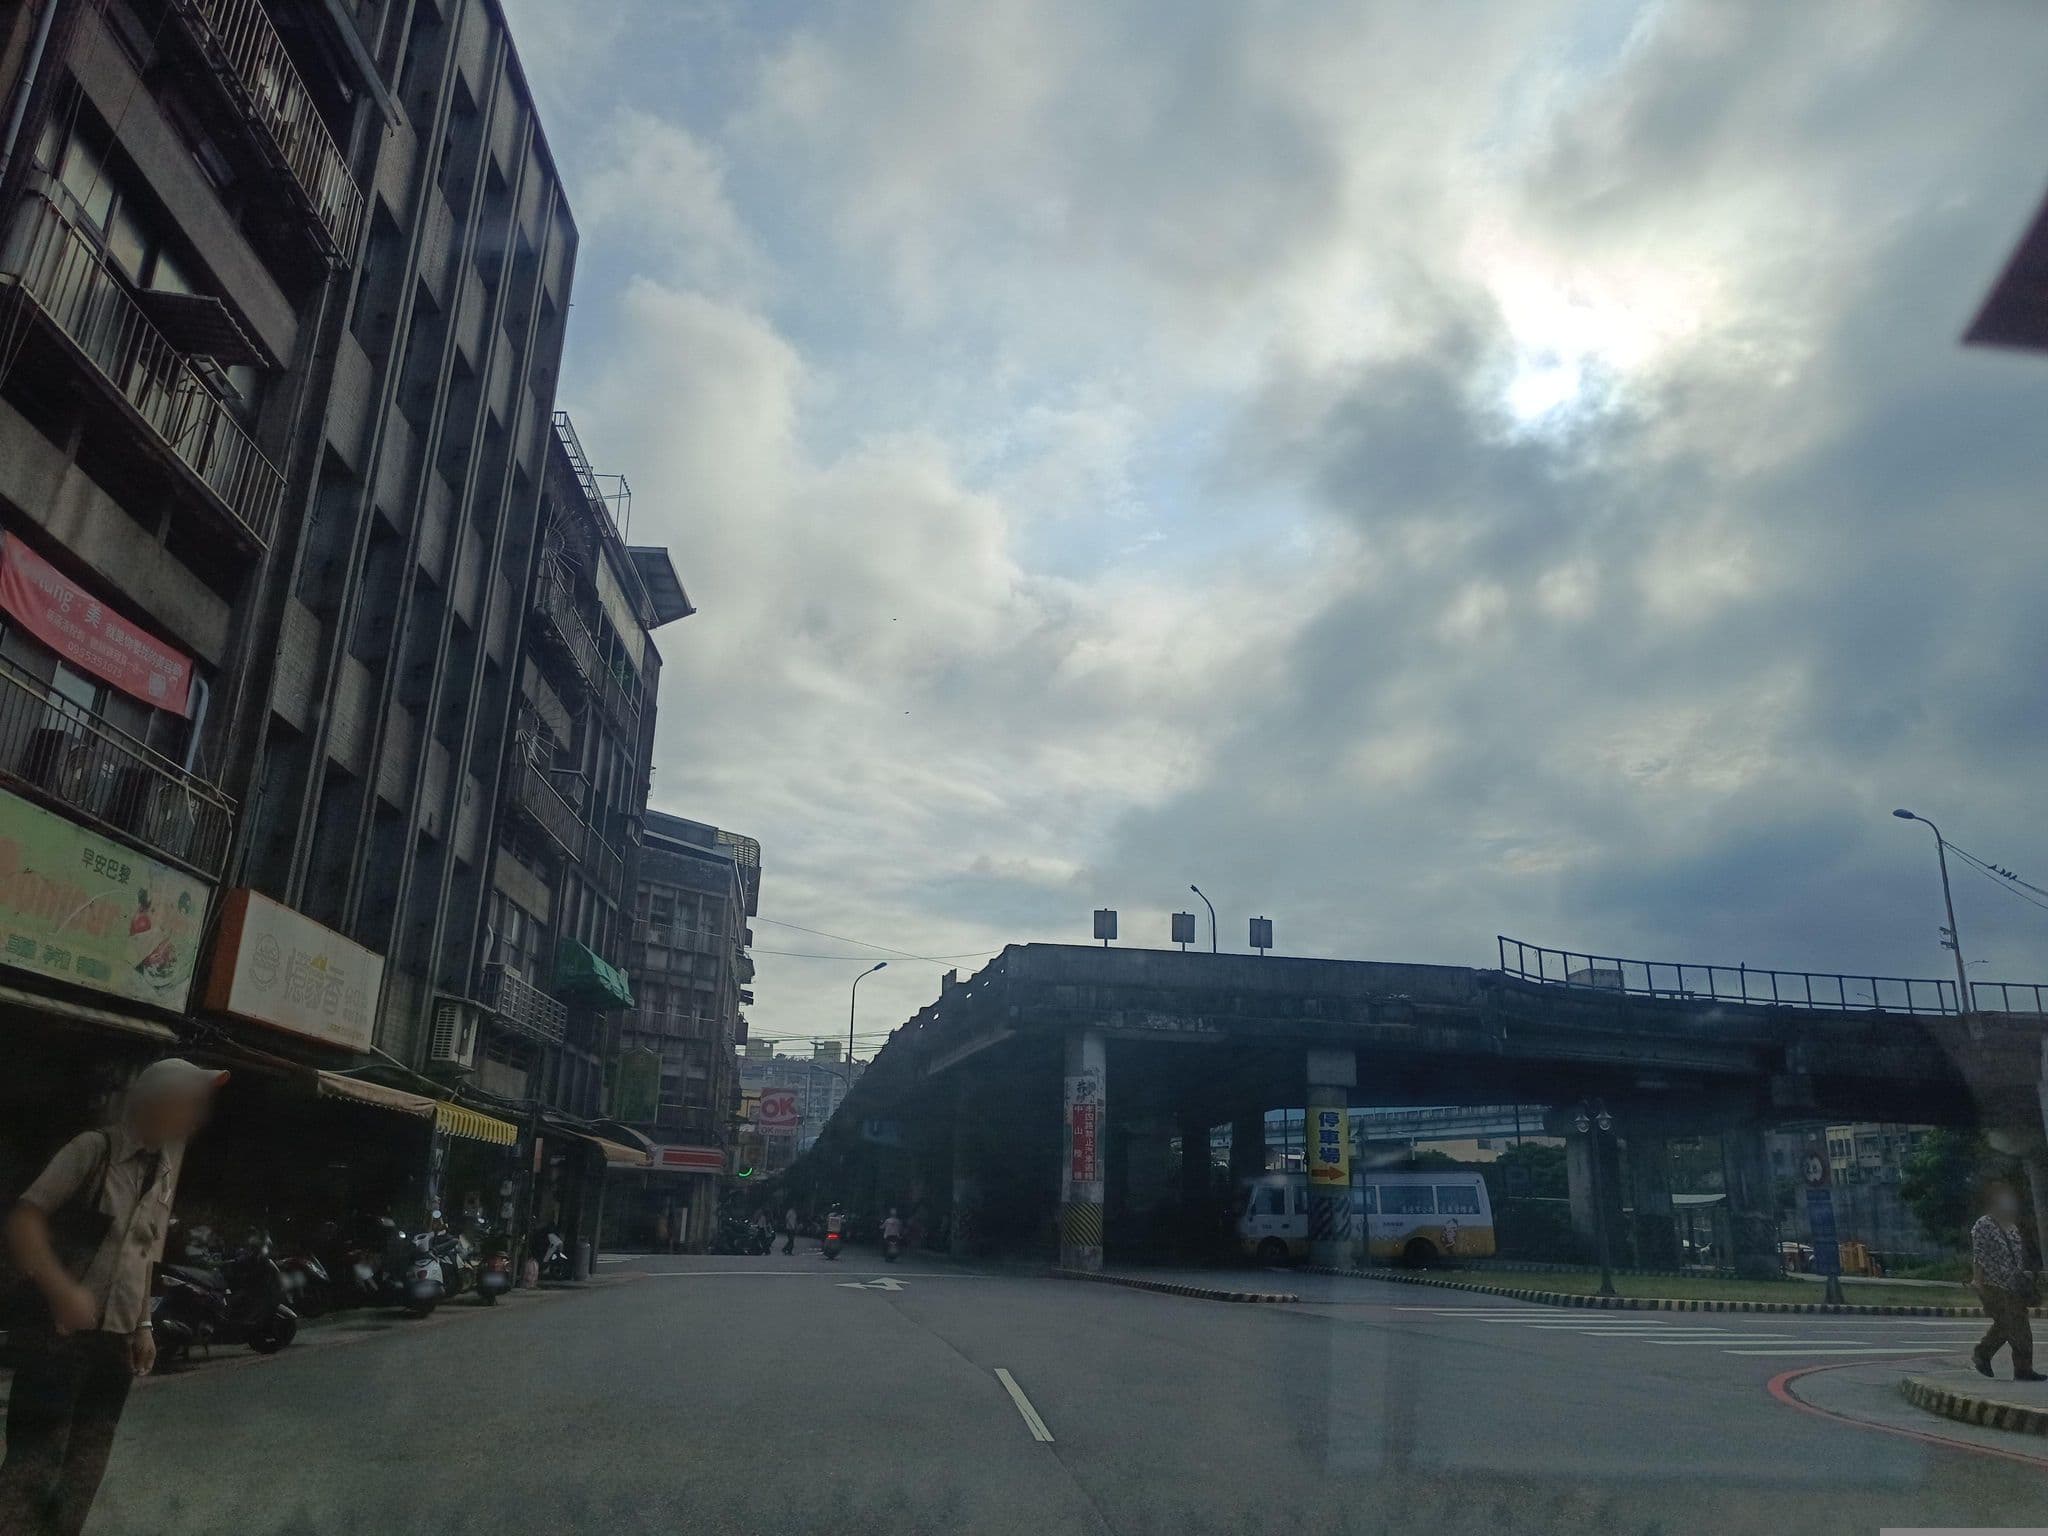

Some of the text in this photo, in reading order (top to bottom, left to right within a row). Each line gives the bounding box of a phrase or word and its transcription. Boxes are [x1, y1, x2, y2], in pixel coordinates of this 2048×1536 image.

[81, 847, 132, 885] 早安巴黎
[762, 1097, 797, 1118] OK
[1318, 1111, 1341, 1164] 停車場
